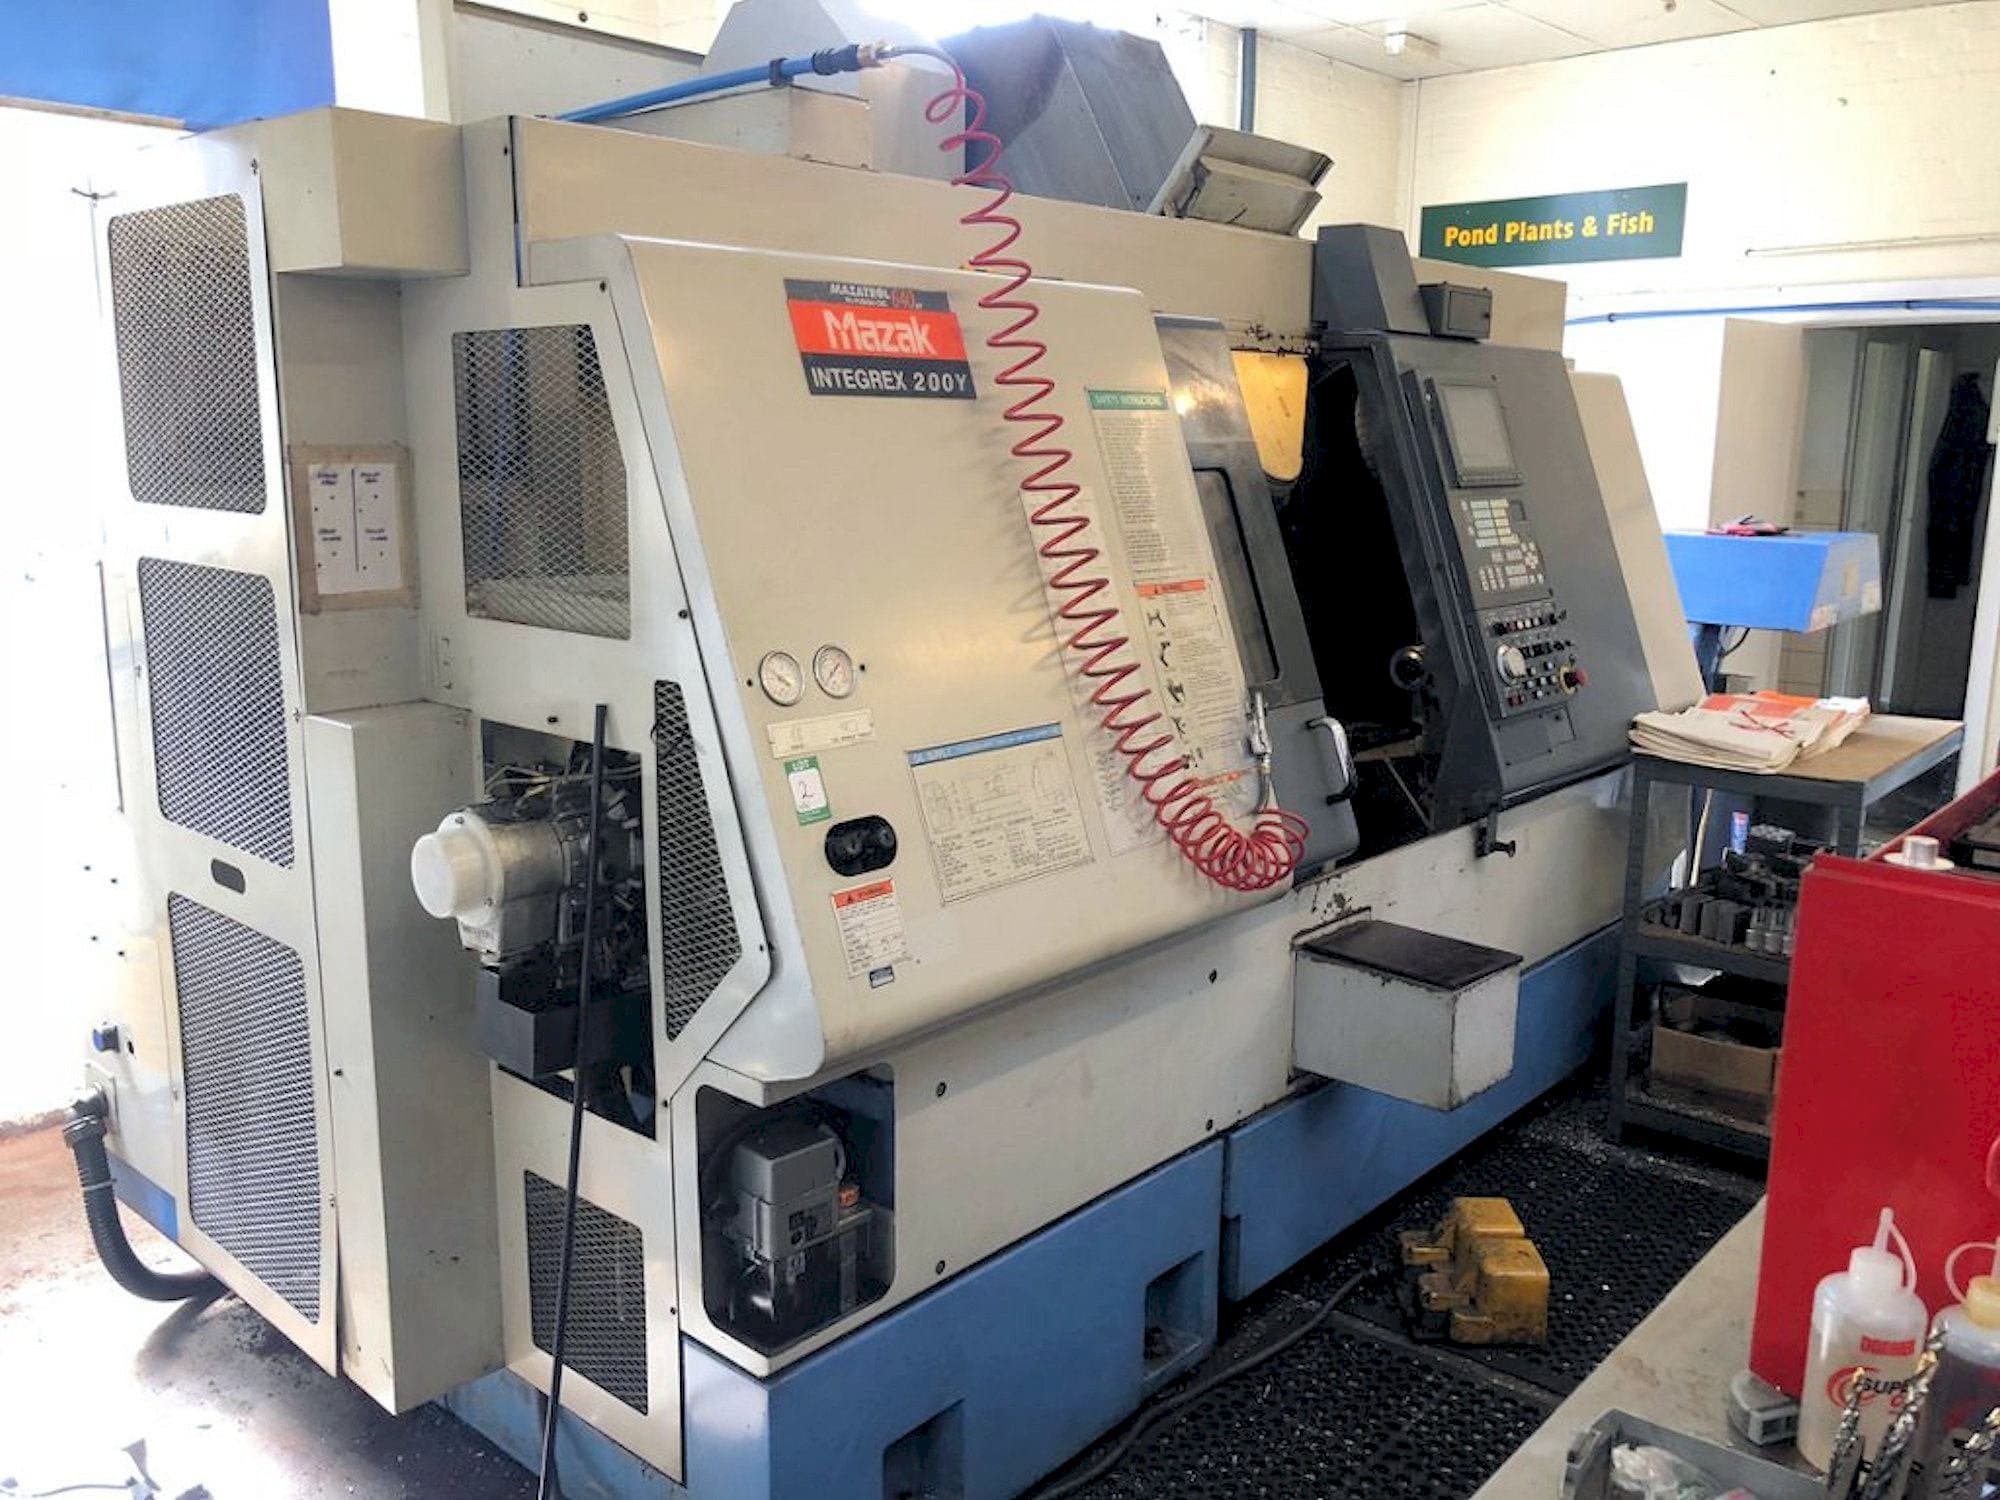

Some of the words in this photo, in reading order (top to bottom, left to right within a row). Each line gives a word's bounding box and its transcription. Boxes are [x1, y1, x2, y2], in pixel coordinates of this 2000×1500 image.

[1444, 224, 1498, 247] Pond
[1505, 221, 1574, 242] Plants
[1581, 215, 1598, 237] &
[1606, 210, 1655, 235] Fish
[822, 310, 938, 355] Mazak
[811, 368, 908, 391] INTEGREX
[913, 373, 968, 392] 200Y
[1863, 1377, 1907, 1394] SUP
